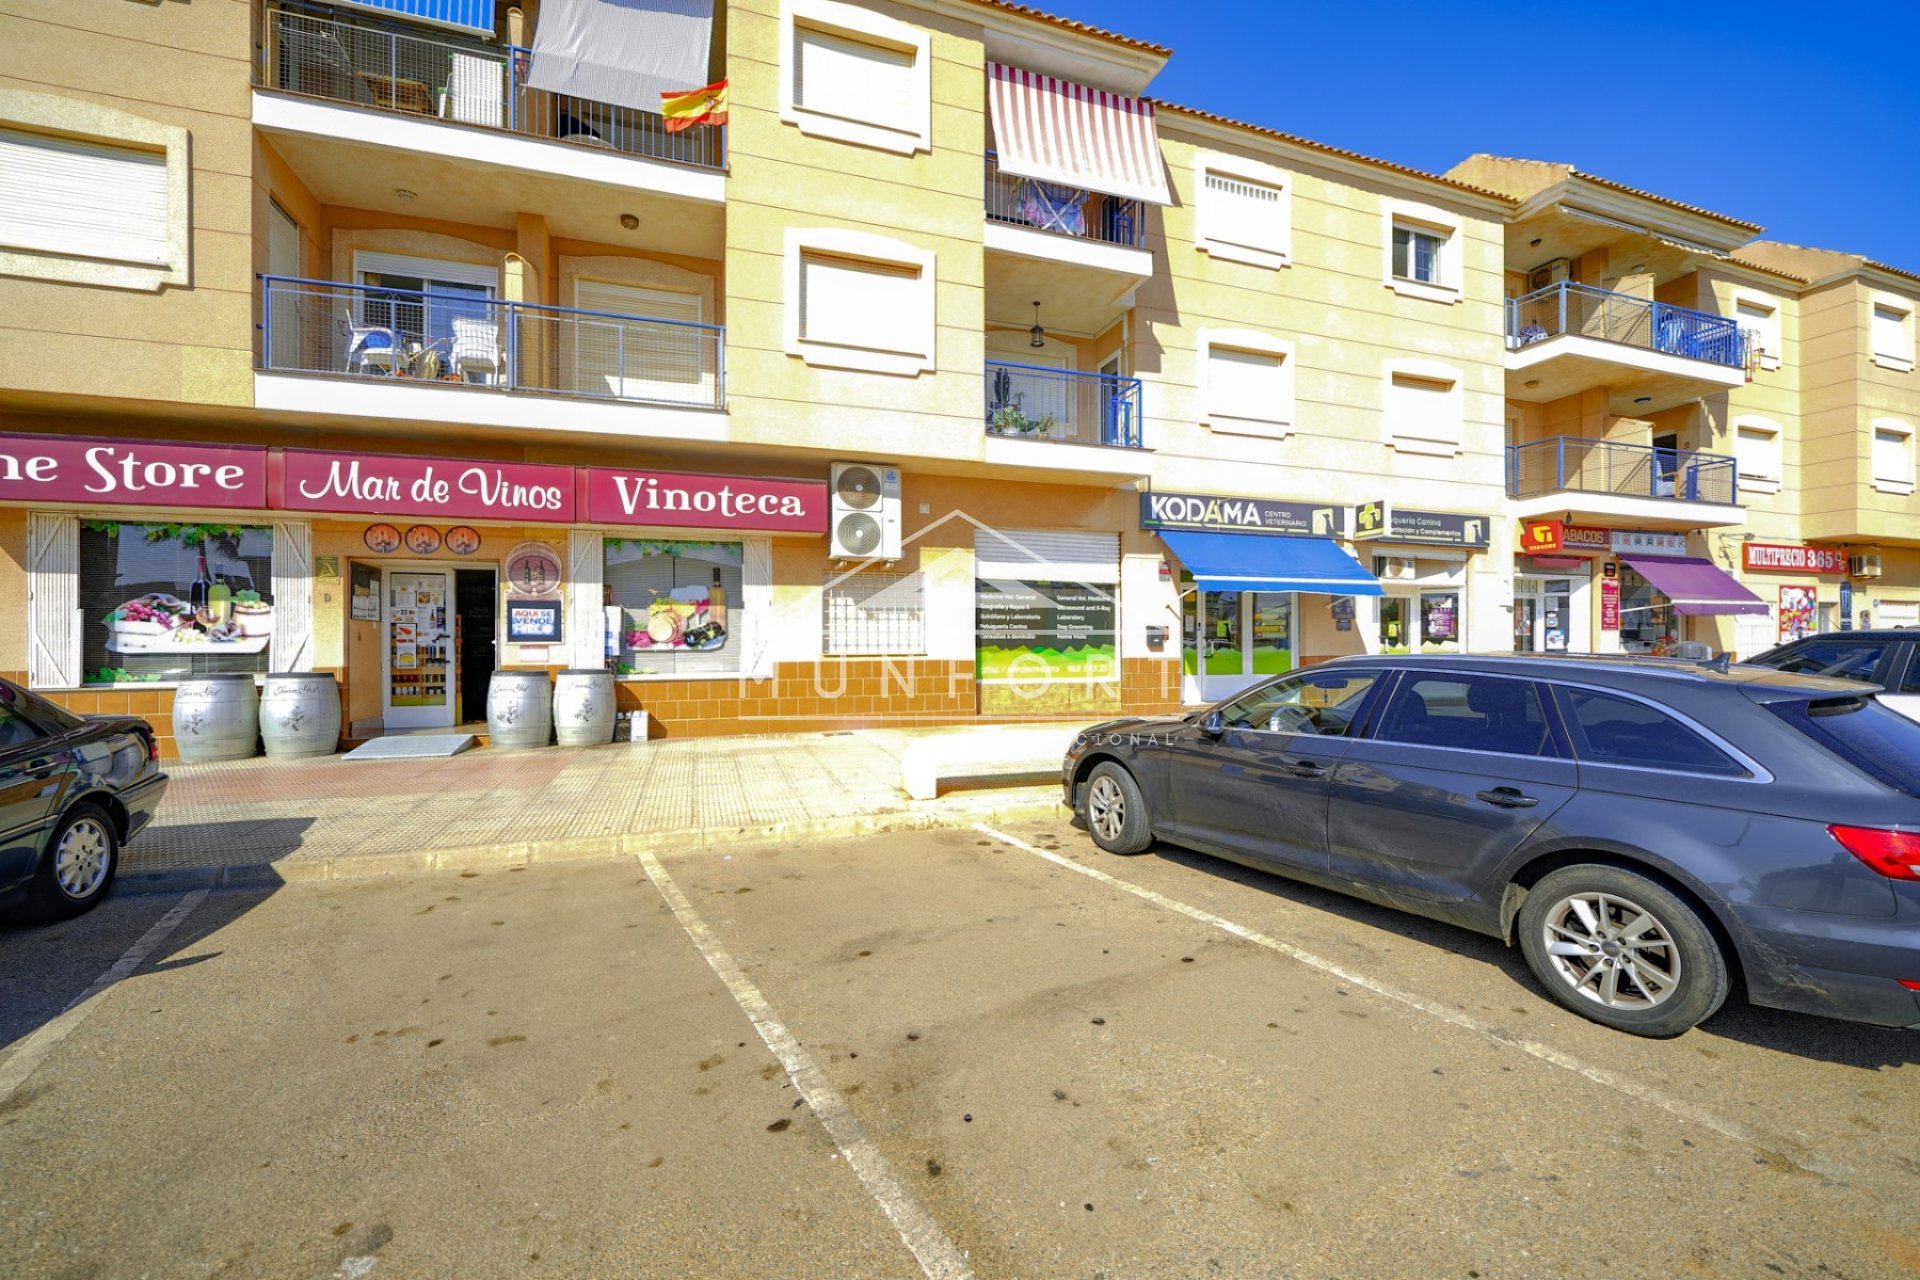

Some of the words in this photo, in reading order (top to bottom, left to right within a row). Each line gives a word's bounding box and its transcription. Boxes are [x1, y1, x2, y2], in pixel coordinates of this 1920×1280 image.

[84, 447, 244, 493] Store
[300, 460, 401, 501] Mar
[411, 467, 449, 503] de
[458, 467, 562, 510] Vinos
[612, 476, 805, 517] Vinoteca
[1151, 495, 1261, 526] KODAMA
[1264, 510, 1291, 519] CENTRO
[1265, 518, 1307, 528] VETERINARIO
[1416, 517, 1442, 527] Canina
[1563, 528, 1604, 544] ABACOS
[1748, 546, 1805, 567] MULTIPRECIO
[514, 617, 553, 625] VENDE
